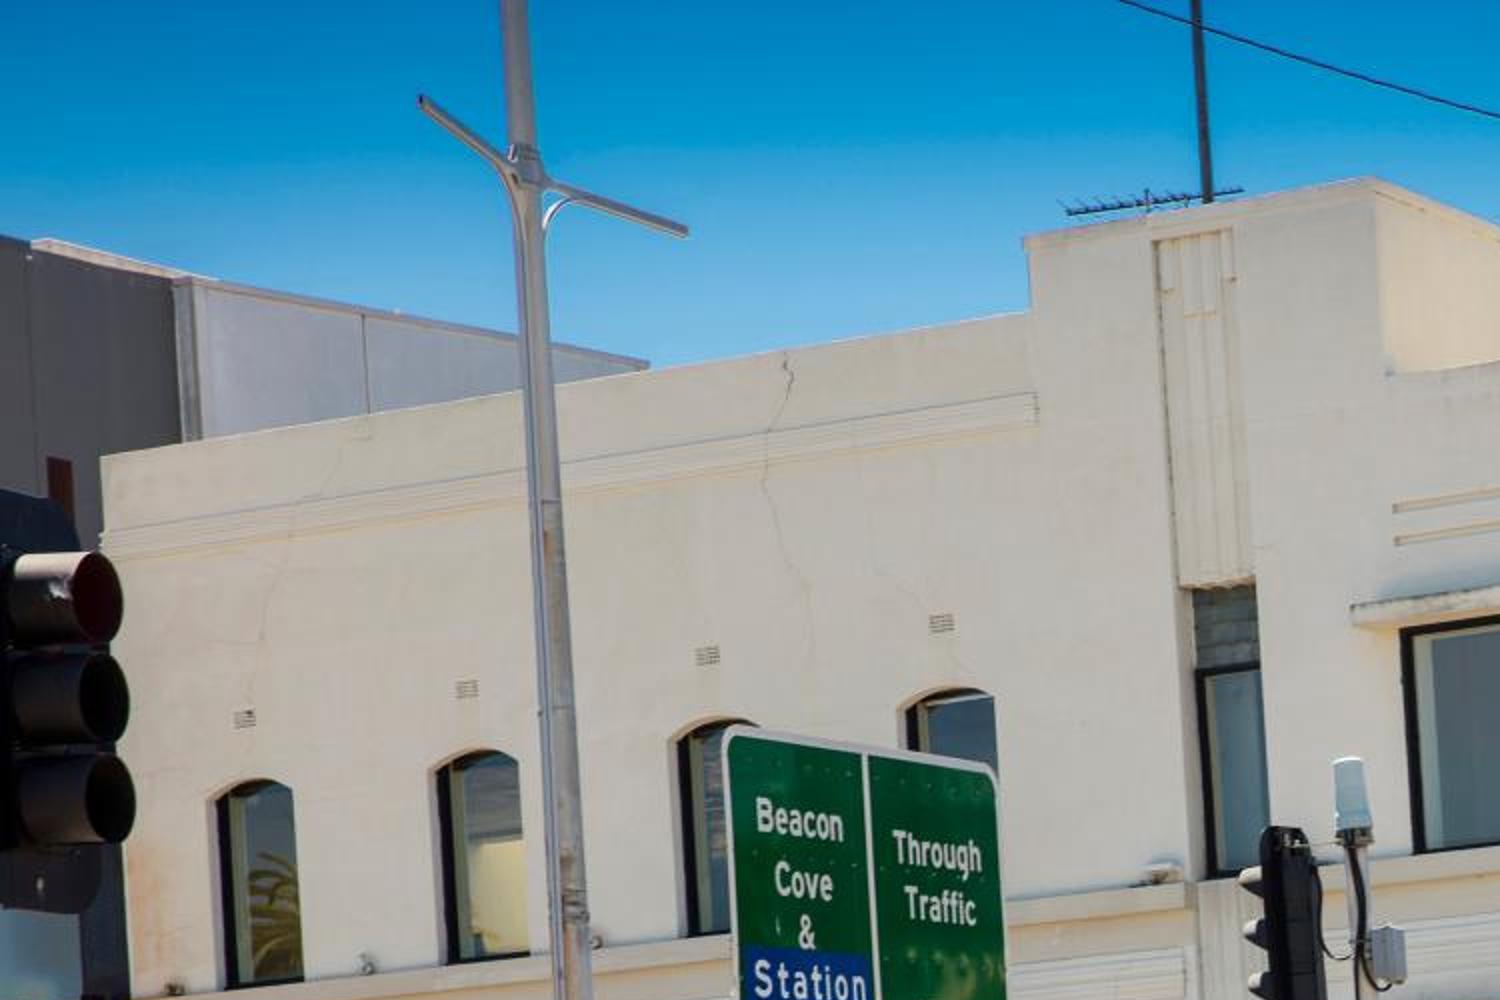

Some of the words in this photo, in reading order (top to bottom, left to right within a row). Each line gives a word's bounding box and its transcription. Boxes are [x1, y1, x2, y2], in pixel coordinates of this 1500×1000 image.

[755, 797, 844, 843] Beacon
[892, 830, 982, 881] Through
[774, 861, 834, 902] Cove
[903, 885, 977, 927] Traffic
[798, 914, 816, 950] &
